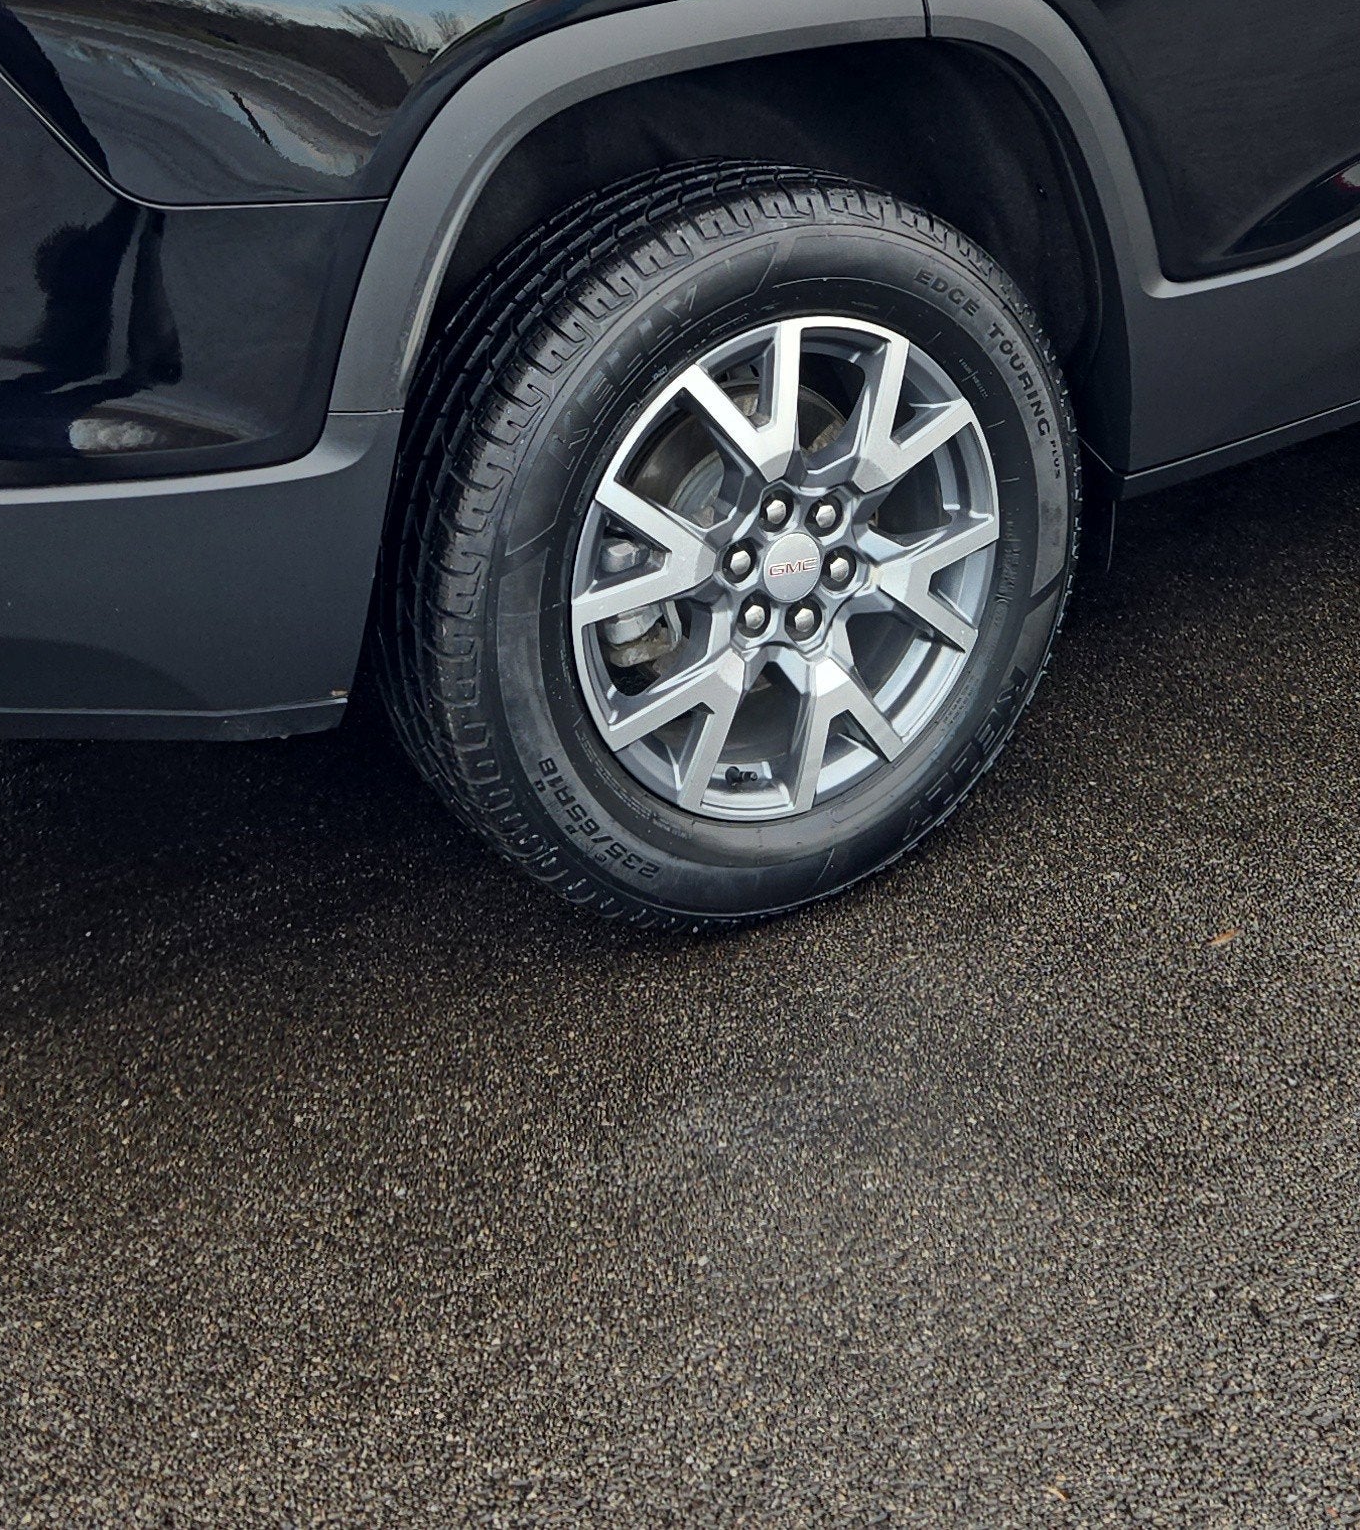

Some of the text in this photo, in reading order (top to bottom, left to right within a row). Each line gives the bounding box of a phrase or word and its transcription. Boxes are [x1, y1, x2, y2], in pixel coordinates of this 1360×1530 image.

[913, 269, 981, 318] EDGE
[987, 322, 1053, 437] TOURING
[768, 557, 818, 577] GMC
